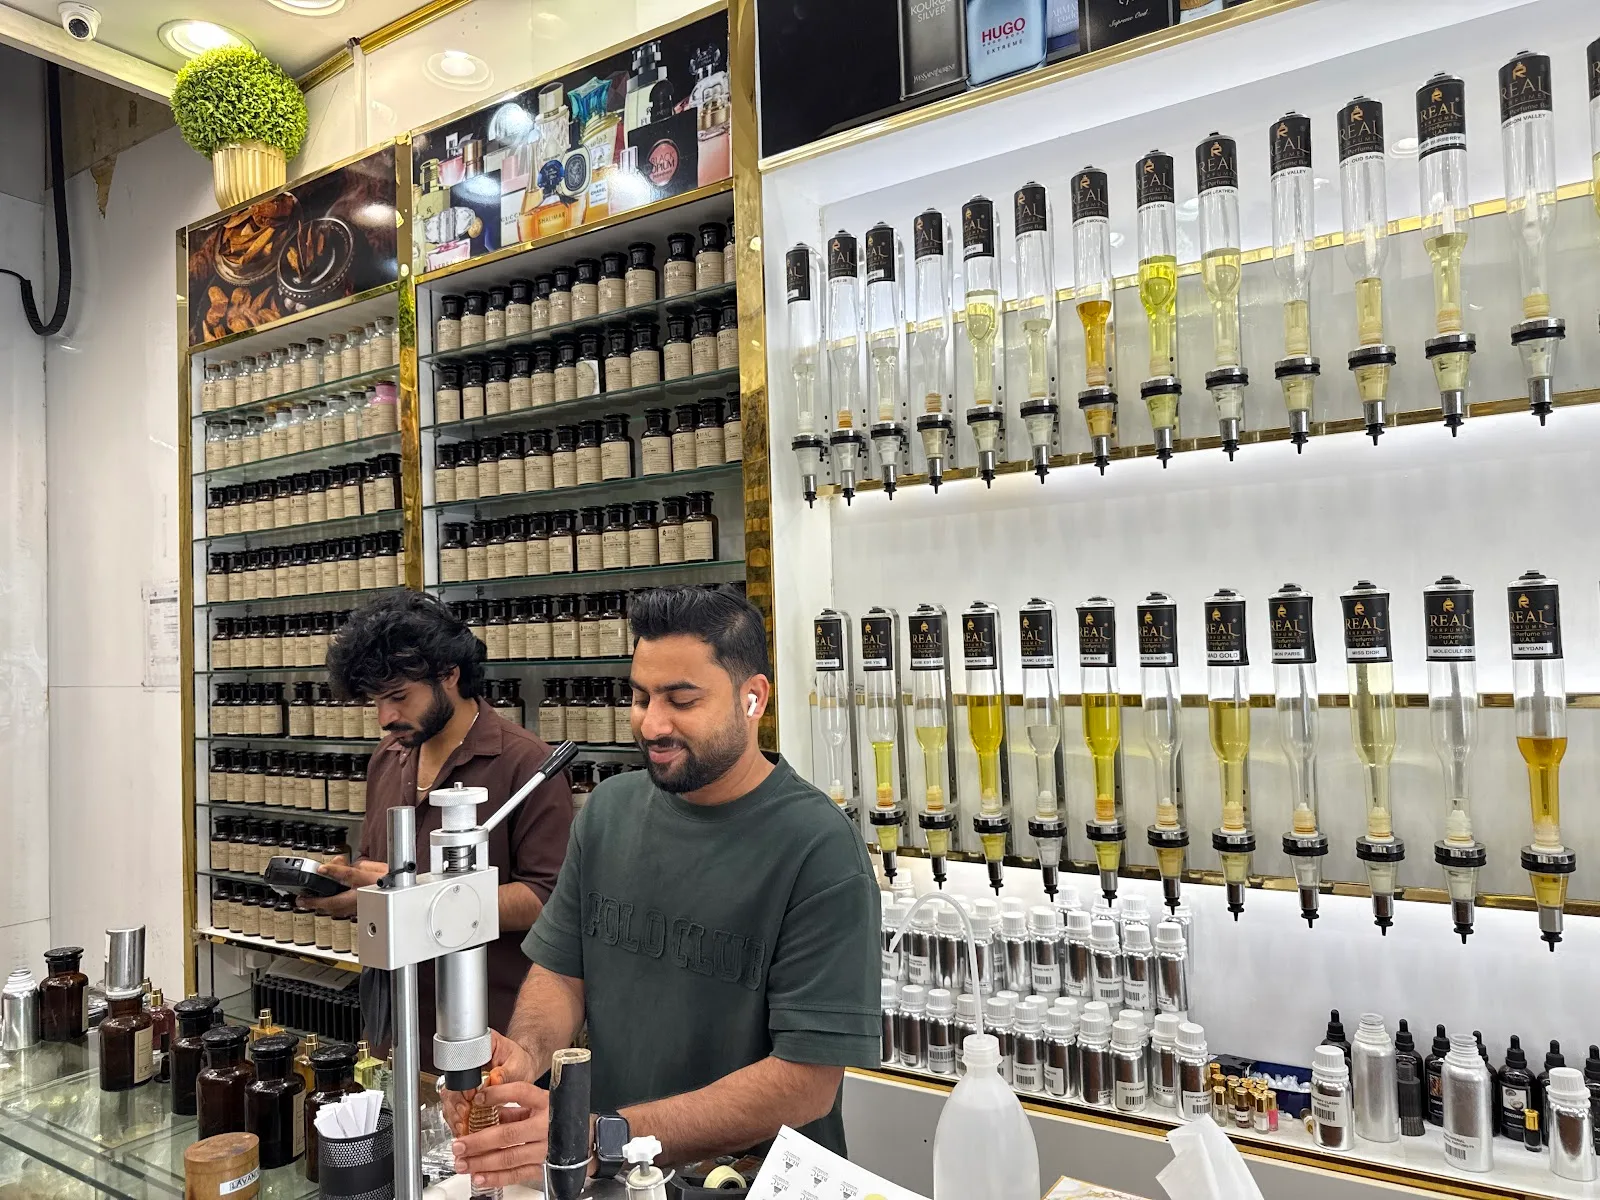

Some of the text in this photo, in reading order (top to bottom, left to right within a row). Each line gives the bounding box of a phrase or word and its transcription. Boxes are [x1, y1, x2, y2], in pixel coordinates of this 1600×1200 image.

[917, 5, 946, 22] SILVER
[982, 17, 1026, 43] HUGO
[986, 39, 1024, 55] EXTREME
[1500, 76, 1551, 100] REAL
[1420, 101, 1463, 122] REAL
[1340, 120, 1383, 140] REAL
[1270, 136, 1310, 156] REAL
[650, 151, 675, 165] BLACK
[1199, 157, 1237, 174] REAL
[1351, 156, 1364, 164] OUD
[1136, 172, 1173, 190] REAL
[1072, 188, 1108, 206] REAL
[538, 212, 566, 225] SHALIMAR
[829, 251, 857, 267] EAL
[1345, 616, 1386, 632] REAL
[1429, 614, 1473, 630] REAL
[1509, 609, 1554, 626] REAL
[1079, 627, 1111, 640] REAL
[1139, 625, 1172, 639] REAL
[1206, 622, 1240, 637] REAL
[1271, 619, 1308, 634] REAL
[912, 633, 942, 645] REAL
[1021, 630, 1046, 643] EAL
[583, 891, 667, 959] POLO
